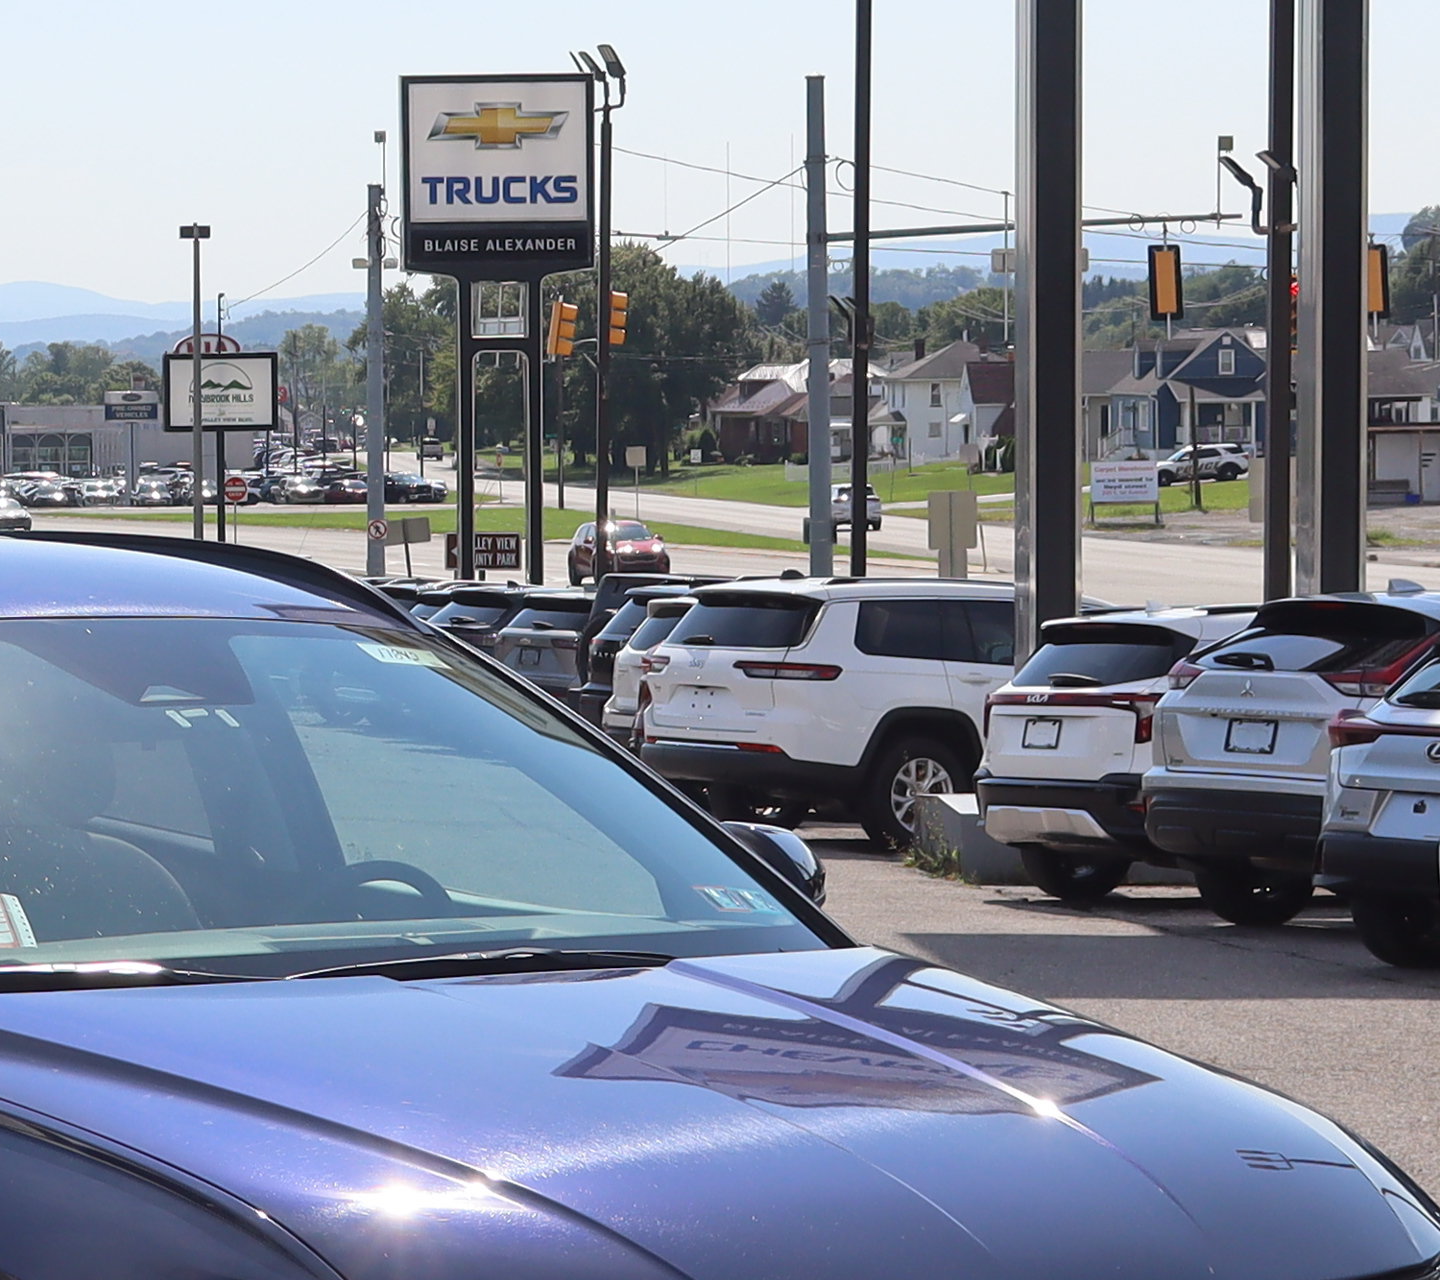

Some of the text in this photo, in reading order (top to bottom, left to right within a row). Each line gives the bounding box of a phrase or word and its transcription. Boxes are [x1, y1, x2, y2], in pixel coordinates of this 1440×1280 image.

[421, 176, 578, 205] TRUCKS
[424, 238, 576, 252] BLAISE ALEXANDER
[231, 394, 254, 403] HILLS
[496, 536, 518, 550] VIEW
[496, 552, 517, 566] PARK
